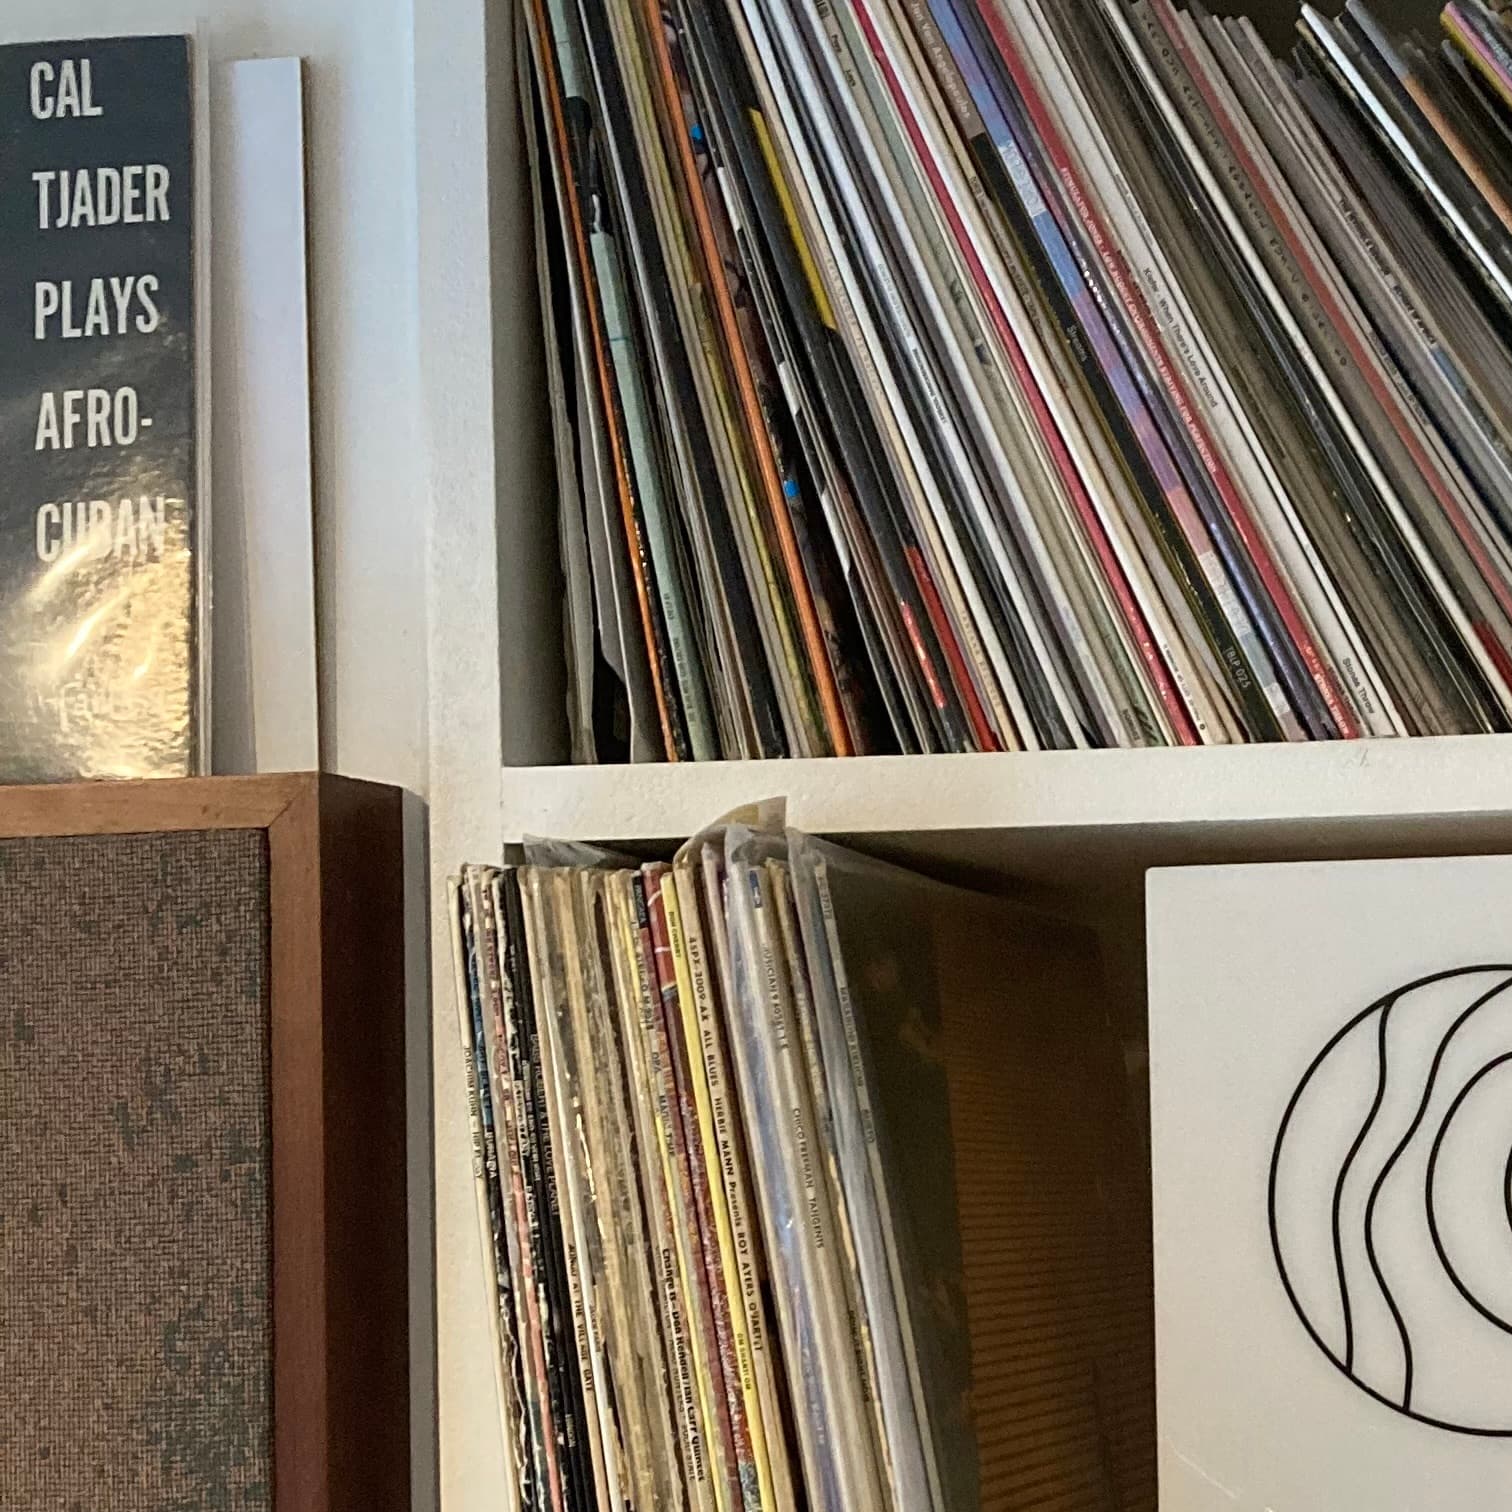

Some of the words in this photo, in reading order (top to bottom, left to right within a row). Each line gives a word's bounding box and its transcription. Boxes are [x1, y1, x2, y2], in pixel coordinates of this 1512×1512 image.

[30, 58, 104, 120] CAL
[32, 164, 170, 230] TJADER
[34, 274, 160, 340] PLAYS
[1141, 266, 1162, 294] Kiefer
[1156, 296, 1177, 323] When
[1169, 322, 1193, 355] There's
[1185, 352, 1204, 377] Love
[1196, 373, 1220, 408] Around
[35, 385, 153, 450] AFRO-
[1340, 655, 1364, 688] Stones
[1355, 685, 1378, 715] Throw
[701, 1028, 714, 1049] ALL
[462, 1045, 475, 1088] JOACHIM
[705, 1053, 721, 1087] BLUES
[540, 1121, 551, 1142] THE
[712, 1096, 729, 1134] HERBIE
[790, 1106, 806, 1141] CHICO
[542, 1144, 555, 1174] LOVE
[719, 1138, 735, 1176] MANN
[796, 1140, 815, 1189] FREEMAN
[726, 1180, 744, 1227] Presents
[806, 1196, 827, 1250] TANGENTS
[735, 1231, 749, 1256] ROY
[659, 1247, 677, 1290] Change
[740, 1261, 756, 1297] AYERS
[573, 1299, 585, 1318] THE
[671, 1311, 683, 1334] Don
[576, 1322, 590, 1361] VILLAGE
[674, 1335, 690, 1381] Rendell
[685, 1405, 698, 1433] Carr
[689, 1435, 706, 1482] Quintet
